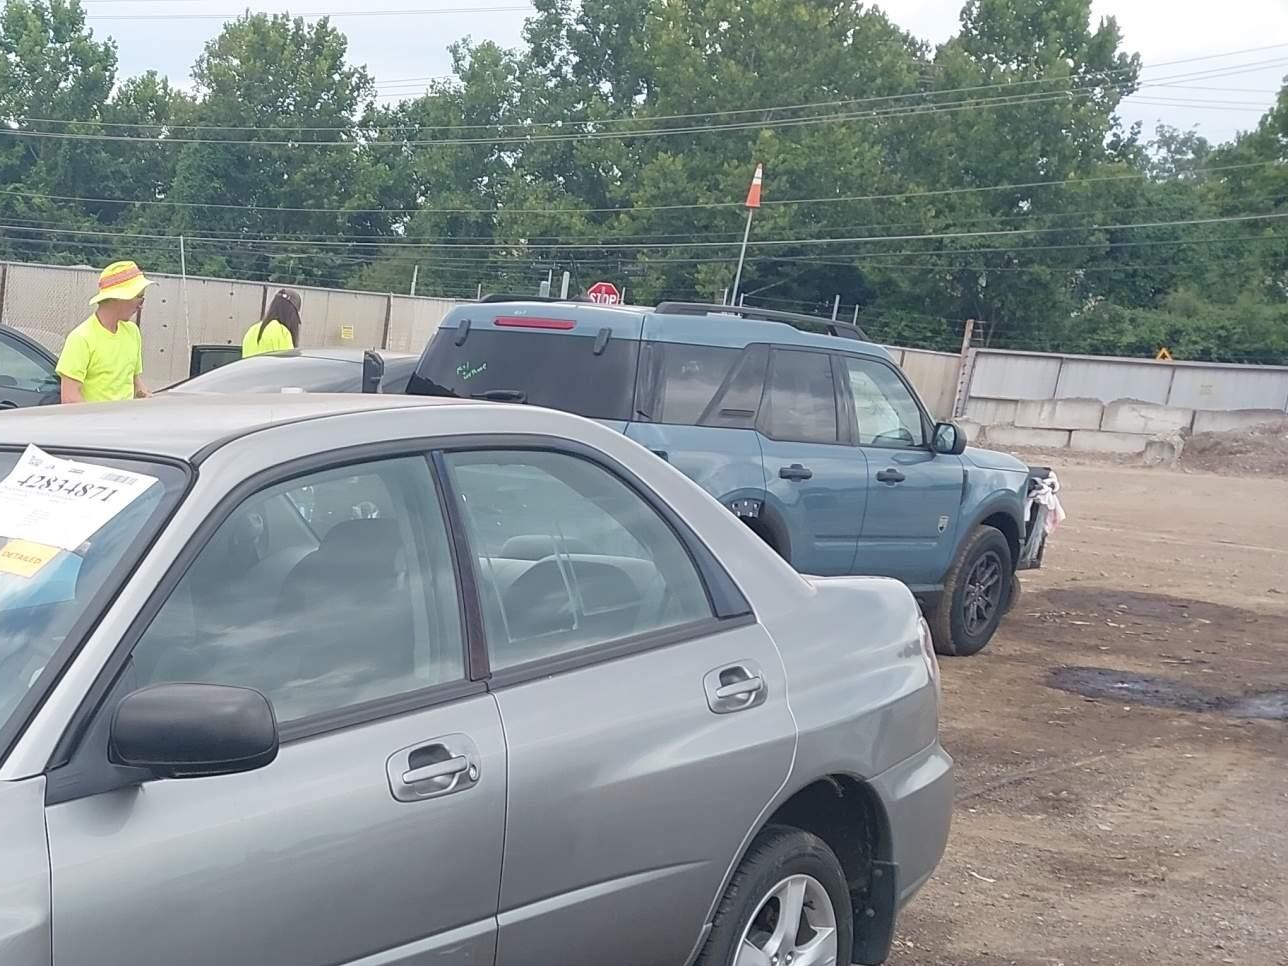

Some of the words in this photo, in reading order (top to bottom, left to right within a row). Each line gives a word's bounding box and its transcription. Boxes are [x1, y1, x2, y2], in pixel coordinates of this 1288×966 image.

[590, 292, 617, 305] STOP
[17, 473, 118, 502] 42834871
[1, 551, 43, 565] DETAILED
